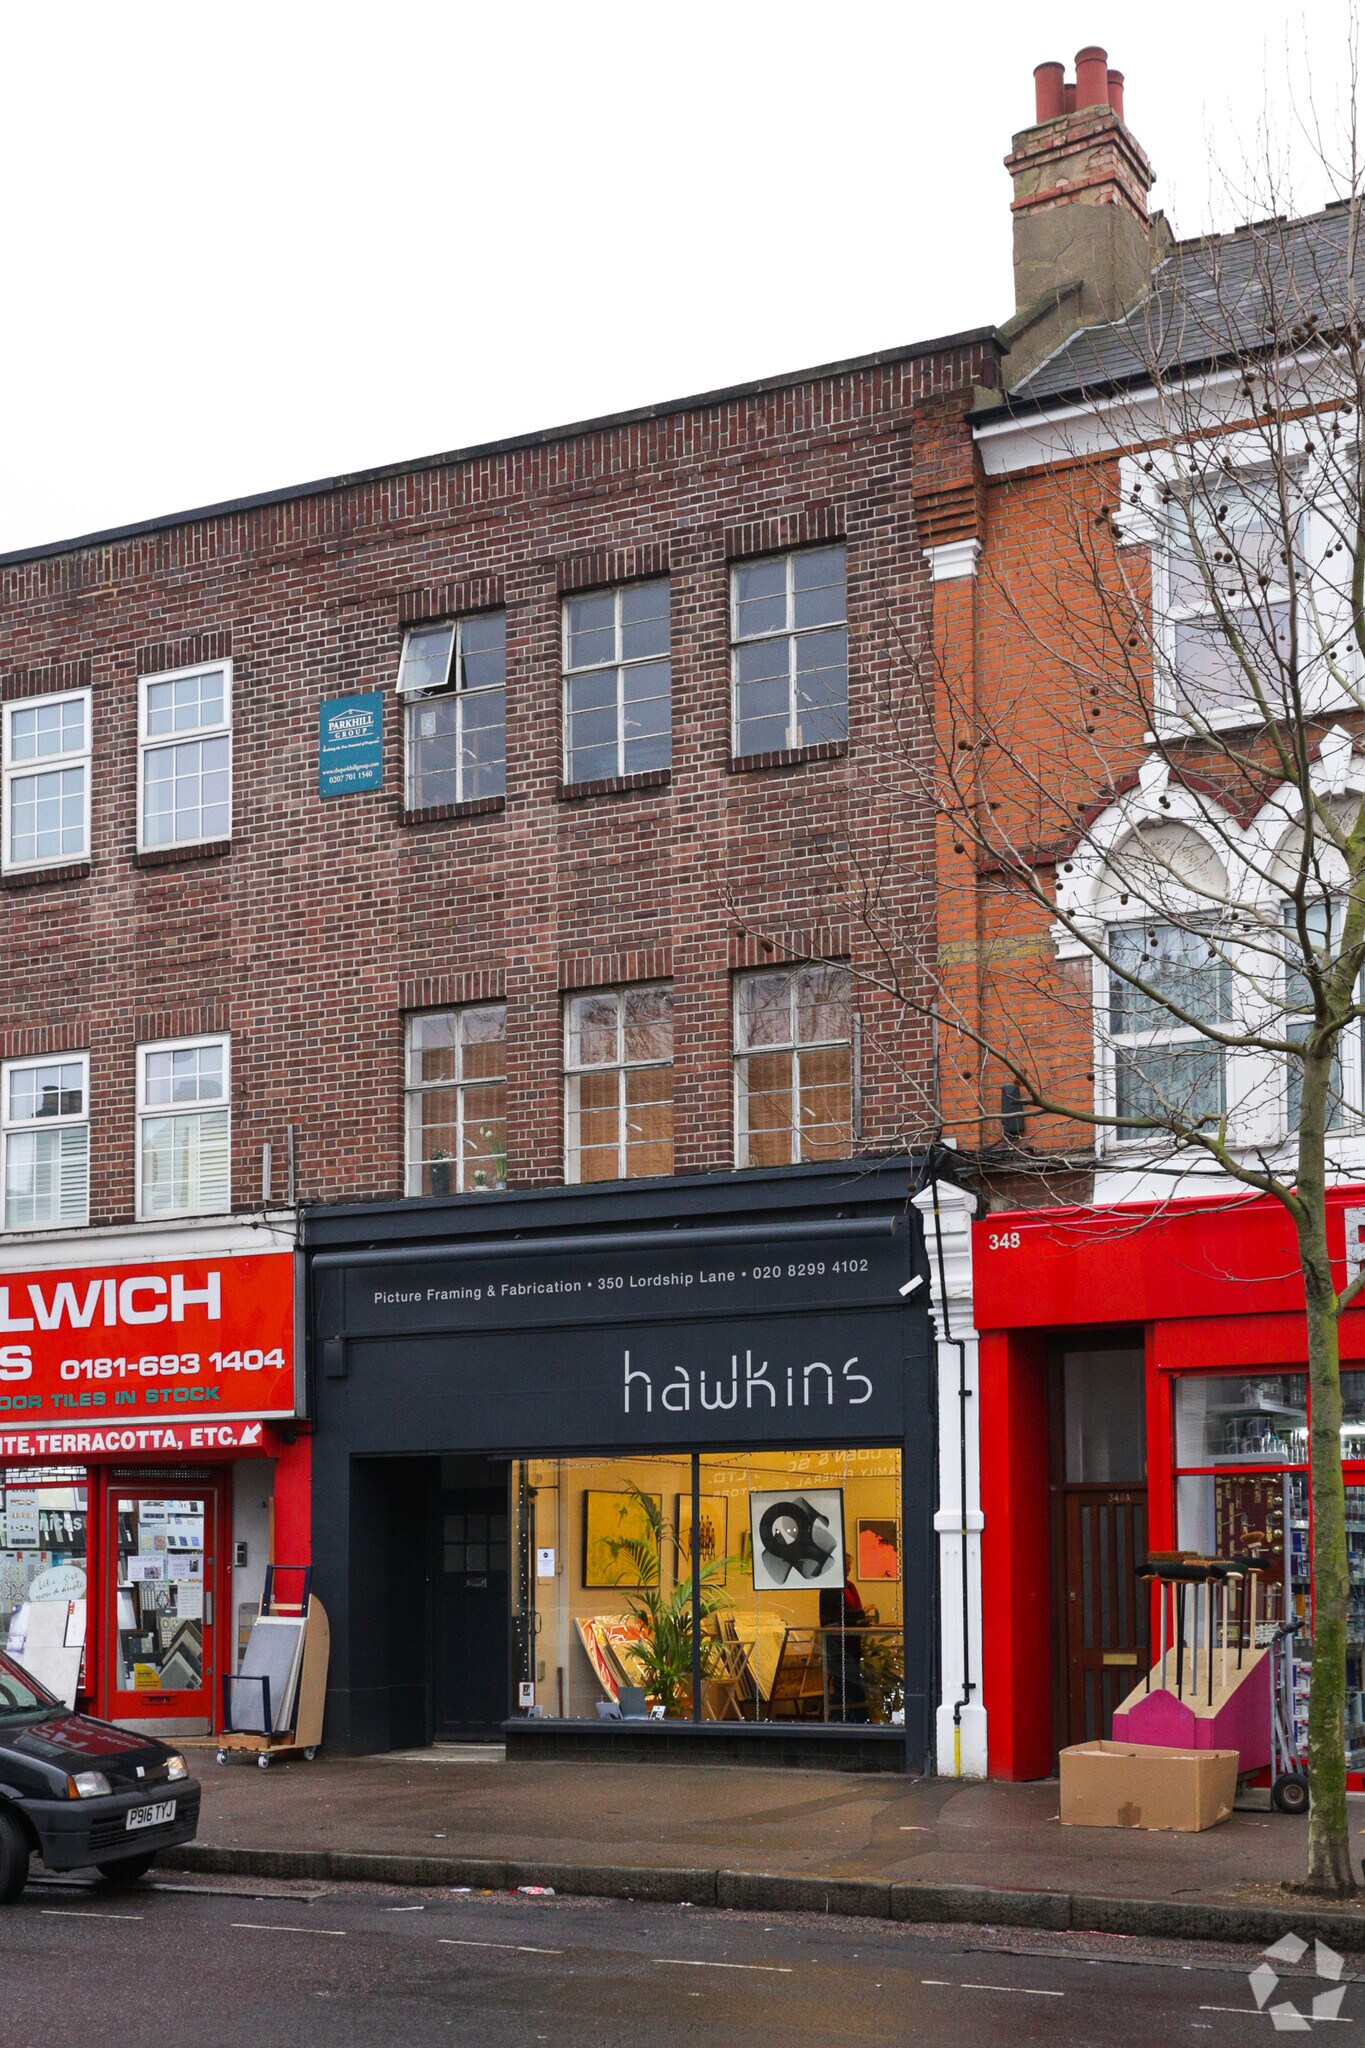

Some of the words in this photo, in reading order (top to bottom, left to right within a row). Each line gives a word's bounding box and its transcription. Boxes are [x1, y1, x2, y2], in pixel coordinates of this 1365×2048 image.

[328, 715, 374, 731] PARKHILL
[334, 728, 368, 739] GROUP
[328, 775, 344, 784] 0207
[345, 772, 356, 781] 701
[358, 770, 373, 779] 1540
[989, 1232, 1021, 1251] 348
[374, 1291, 422, 1304] Picture
[427, 1286, 481, 1301] Framing
[487, 1285, 496, 1297] &
[501, 1279, 582, 1296] Fabrication
[597, 1276, 624, 1290] 350
[629, 1271, 694, 1288] Lordship
[700, 1270, 736, 1283] Lane
[752, 1265, 781, 1280] 020
[787, 1262, 826, 1277] 8299
[832, 1259, 869, 1273] 4102
[0, 1271, 221, 1333] LWICH
[0, 1345, 33, 1381] S
[60, 1353, 200, 1380] 0181-693
[208, 1348, 285, 1372] 1404
[624, 1350, 873, 1413] hawkins
[51, 1392, 106, 1408] TILES
[115, 1390, 136, 1405] IN
[145, 1386, 221, 1403] STOCK
[190, 1425, 238, 1447] ETC.
[129, 1806, 153, 1826] P916
[156, 1801, 174, 1820] TYJ
